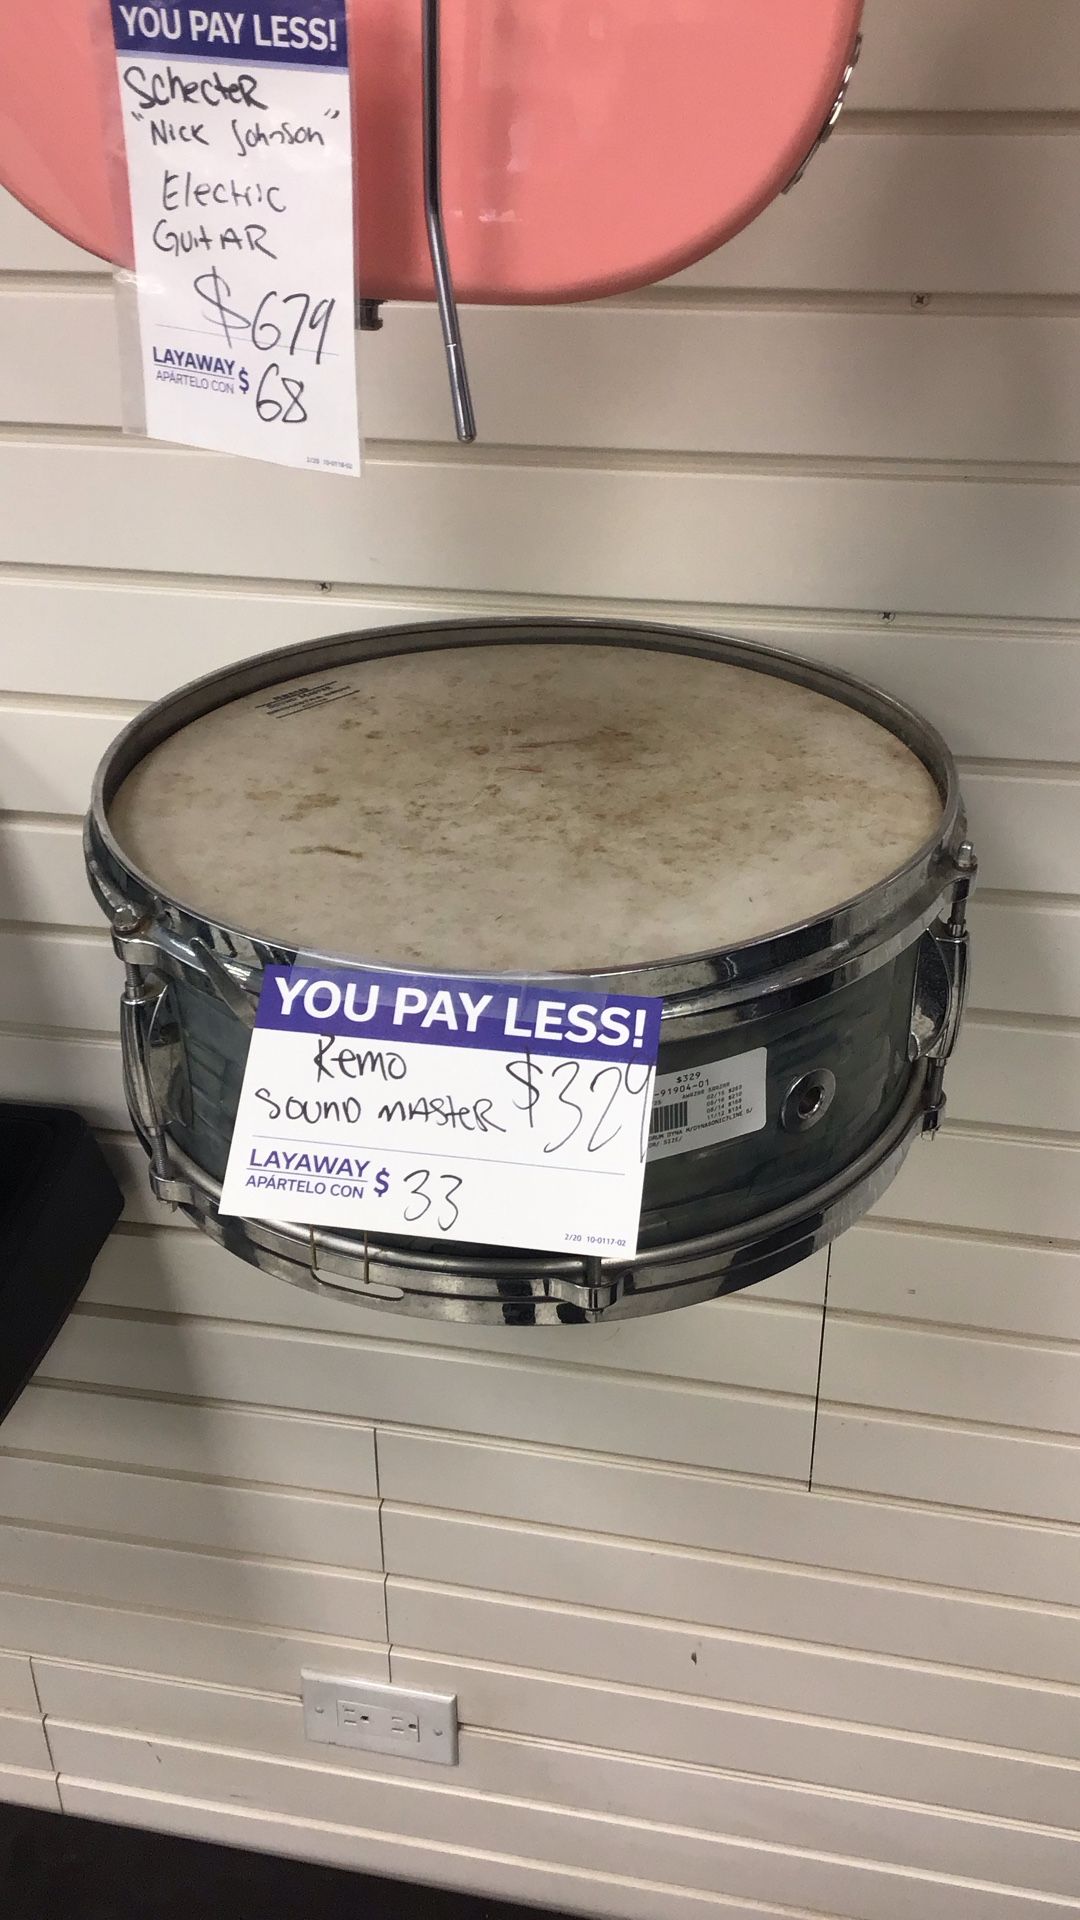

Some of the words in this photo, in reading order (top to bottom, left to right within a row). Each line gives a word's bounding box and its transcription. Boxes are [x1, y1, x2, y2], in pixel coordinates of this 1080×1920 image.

[119, 5, 181, 39] YOU
[190, 10, 244, 44] PAY
[253, 14, 337, 51] LESS!
[194, 265, 336, 365] $679
[152, 346, 235, 376] LAYAWAY
[211, 380, 235, 394] CON
[238, 367, 250, 394] $
[256, 363, 307, 423] 68
[274, 977, 379, 1023] YOU
[392, 988, 494, 1032] PAY
[504, 998, 647, 1049] LESS!
[313, 1034, 407, 1082] Remo
[676, 1071, 701, 1083] $329
[505, 1047, 652, 1163] $329
[249, 1149, 371, 1177] LAYAWAY
[245, 1174, 326, 1195] APÁRTELO
[330, 1184, 364, 1199] CON
[373, 1167, 390, 1197] $
[403, 1169, 463, 1231] 33
[564, 1233, 582, 1242] 2/20
[587, 1236, 626, 1247] 10-0117-02
